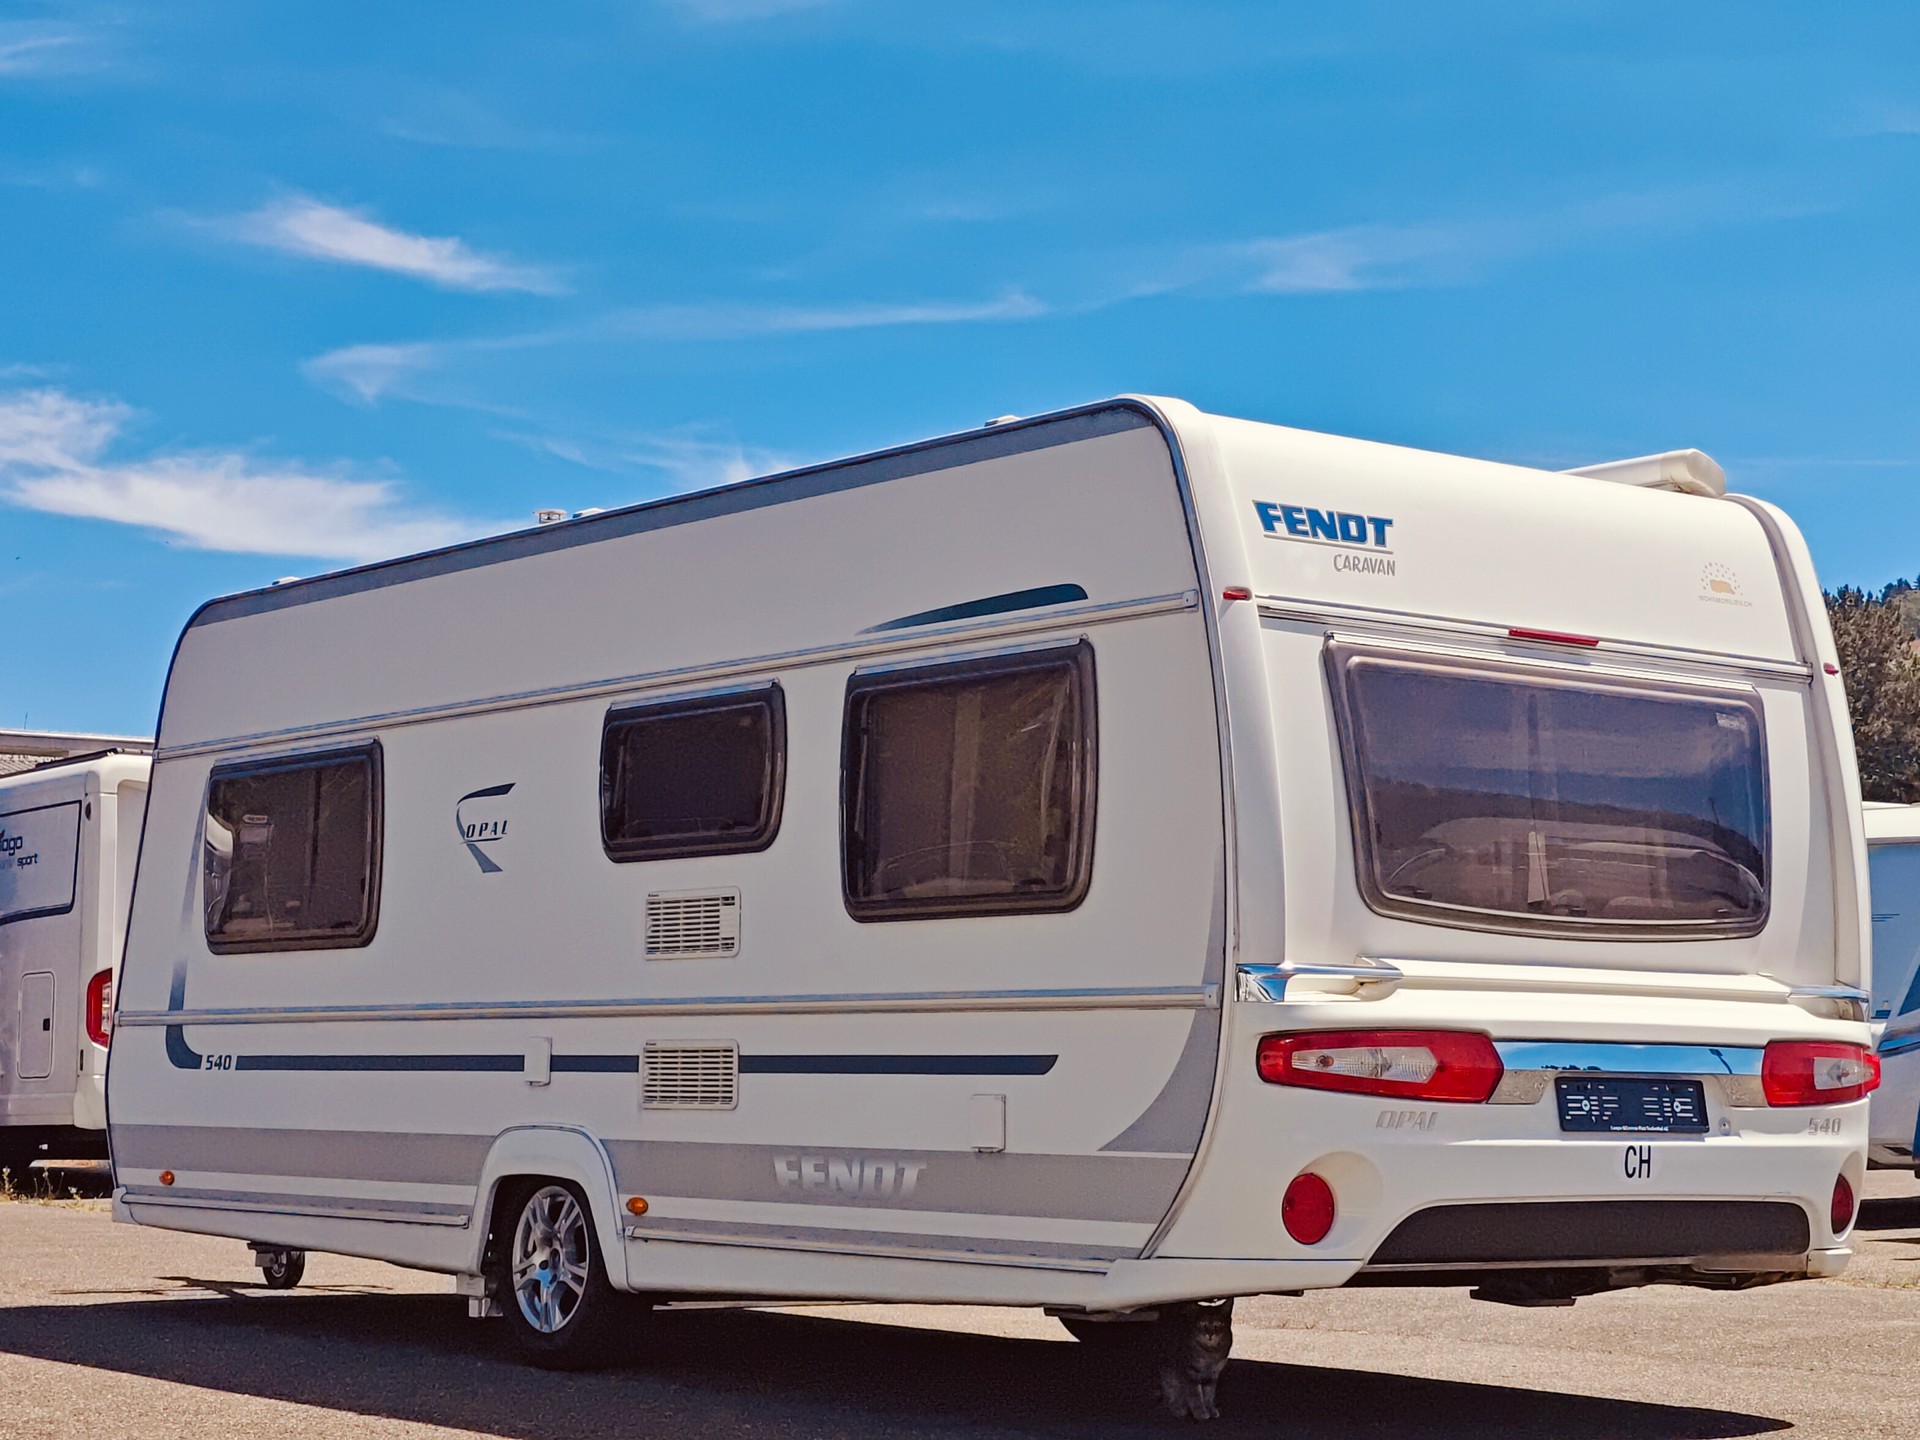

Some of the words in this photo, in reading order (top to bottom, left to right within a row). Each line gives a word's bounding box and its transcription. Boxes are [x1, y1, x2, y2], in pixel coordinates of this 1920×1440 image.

[1252, 499, 1394, 549] FENDT
[1333, 553, 1396, 577] CARAVAN
[466, 820, 508, 839] OPAL
[205, 1054, 232, 1071] 540
[1808, 1117, 1842, 1136] 540
[1624, 1145, 1652, 1179] CH
[772, 1153, 928, 1200] FENDT
